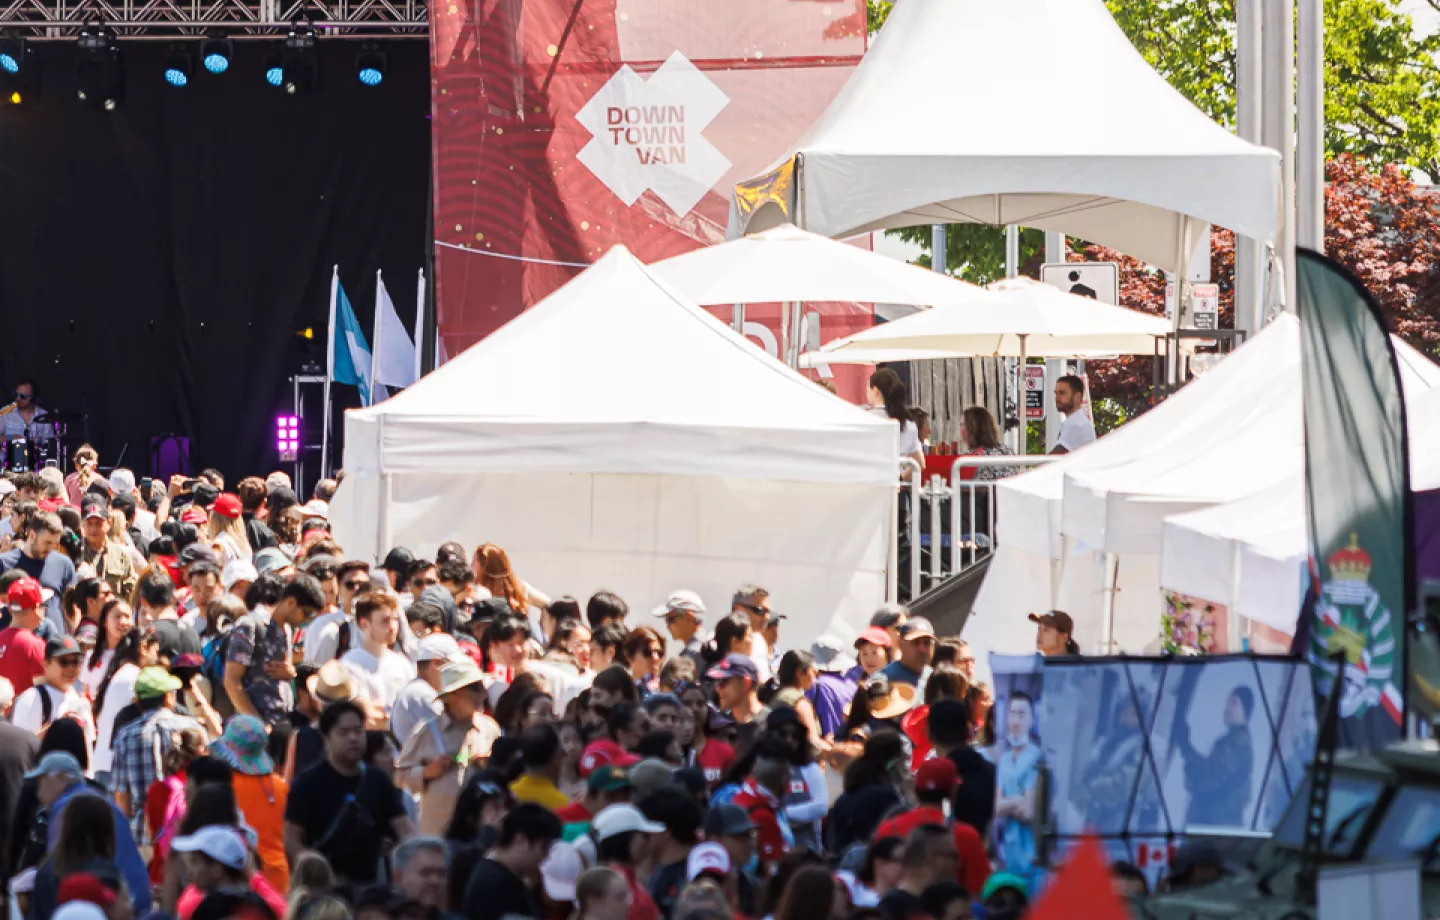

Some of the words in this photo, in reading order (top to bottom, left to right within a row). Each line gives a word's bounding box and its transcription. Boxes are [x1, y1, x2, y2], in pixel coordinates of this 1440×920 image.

[607, 105, 685, 125] DOWN
[608, 126, 685, 145] TOWN
[635, 146, 686, 165] VAN
